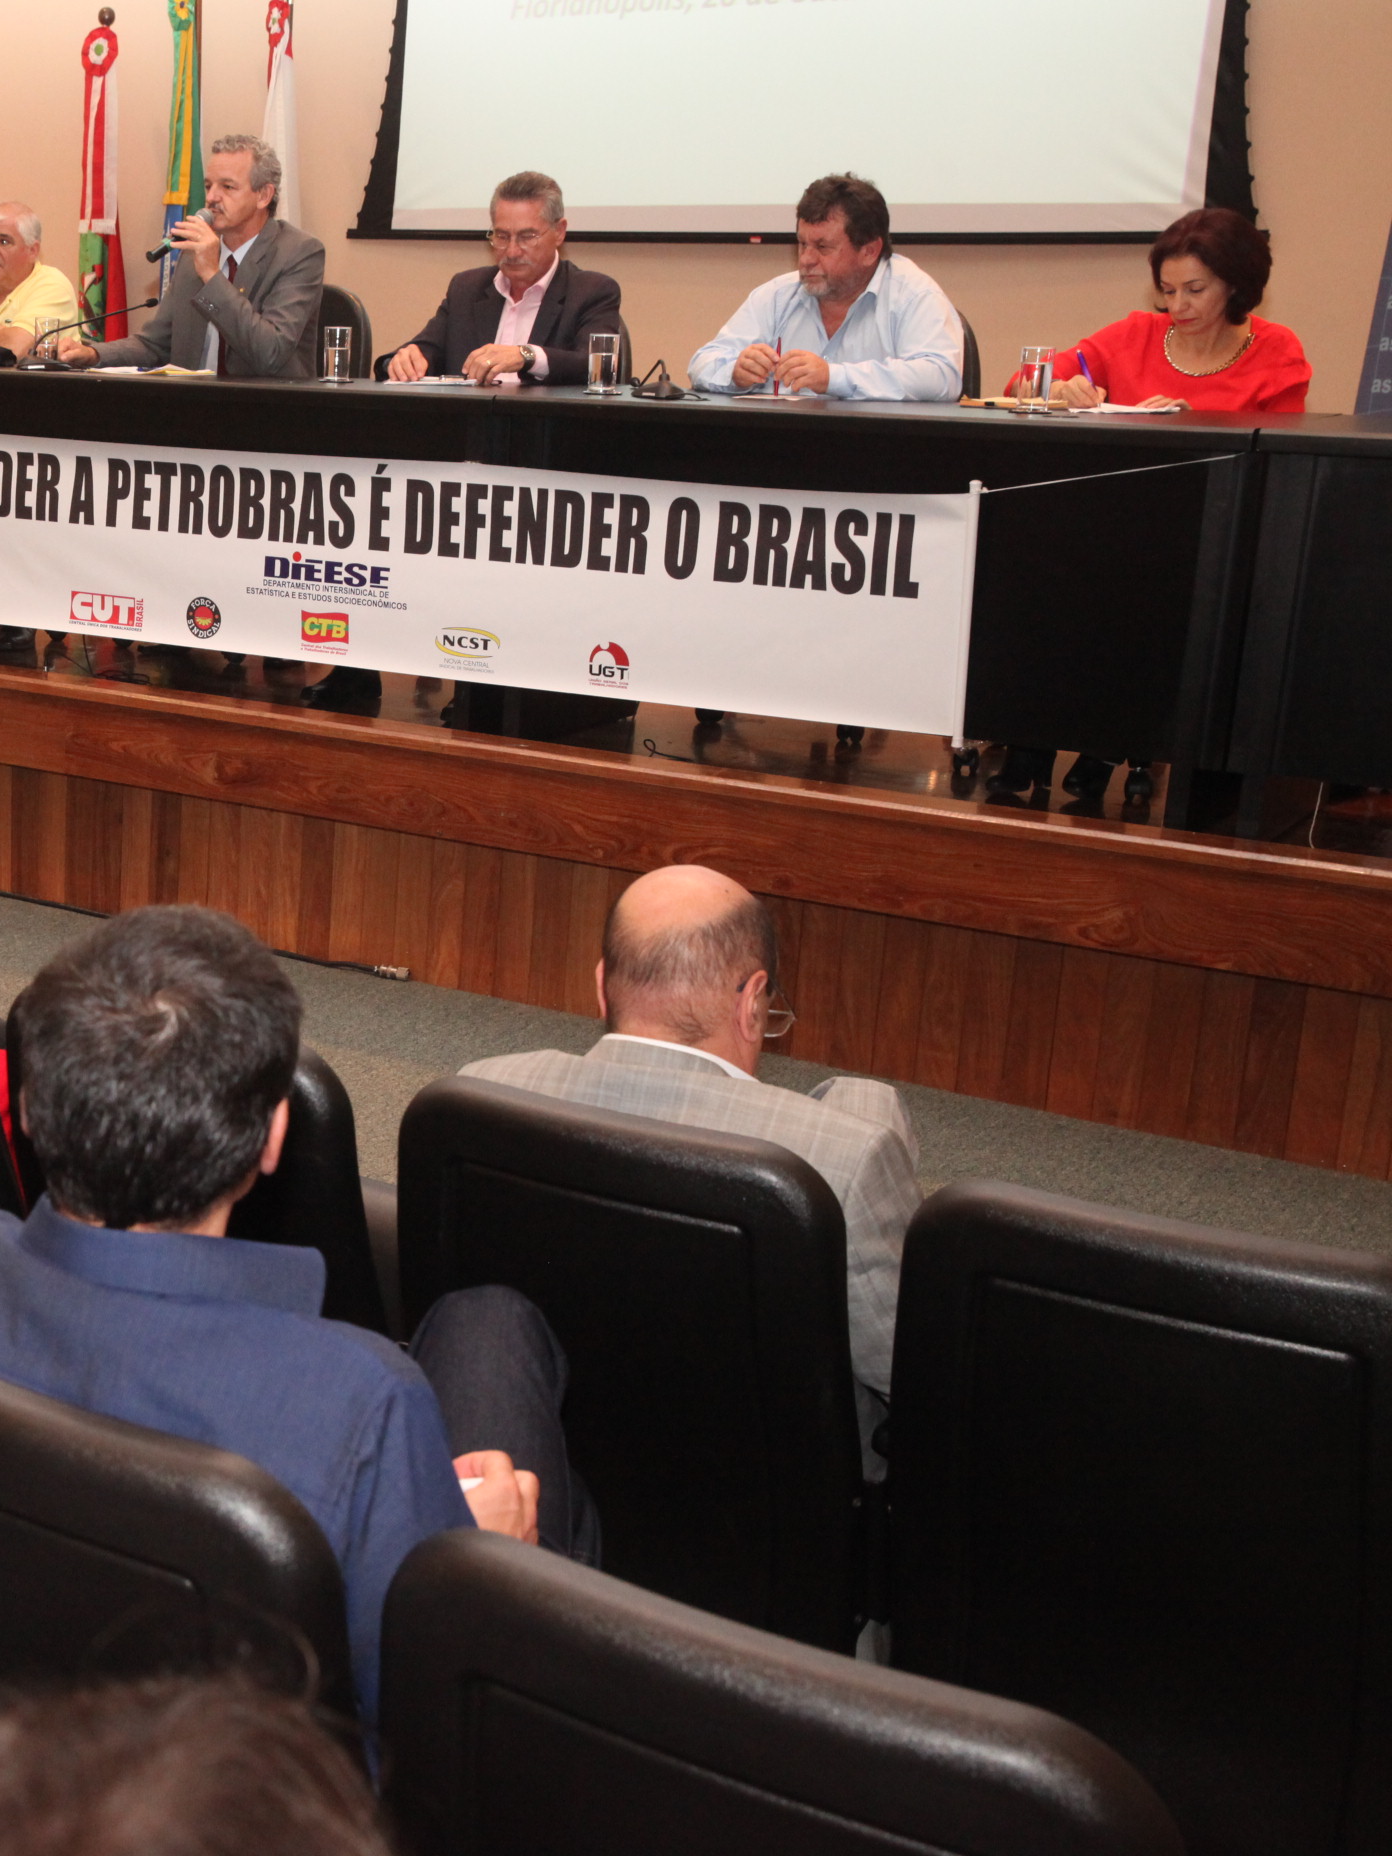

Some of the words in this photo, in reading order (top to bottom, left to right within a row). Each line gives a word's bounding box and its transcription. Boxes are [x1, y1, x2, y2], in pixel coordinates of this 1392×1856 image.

[68, 455, 94, 525] A
[106, 458, 356, 549] PETROBRAS
[368, 464, 392, 552] É
[404, 478, 650, 575] DEFENDER
[664, 496, 700, 580] O
[713, 501, 919, 599] BRASIL
[246, 587, 290, 598] ESTATÍSTICA
[298, 593, 332, 603] ESTUDOS
[333, 595, 408, 611] SOCIOECONÔMICOS
[263, 578, 321, 592] DEPARTAMENTO
[322, 585, 377, 598] INTERSINDICAL
[379, 591, 390, 599] DE
[71, 592, 135, 625] CUT
[135, 598, 144, 628] BRASIL
[191, 598, 216, 612] FORÇA
[187, 618, 220, 639] SINDICAL
[303, 616, 347, 639] CTB
[442, 634, 492, 651] NCST
[463, 660, 489, 669] CENTRAL
[589, 664, 628, 680] UGT
